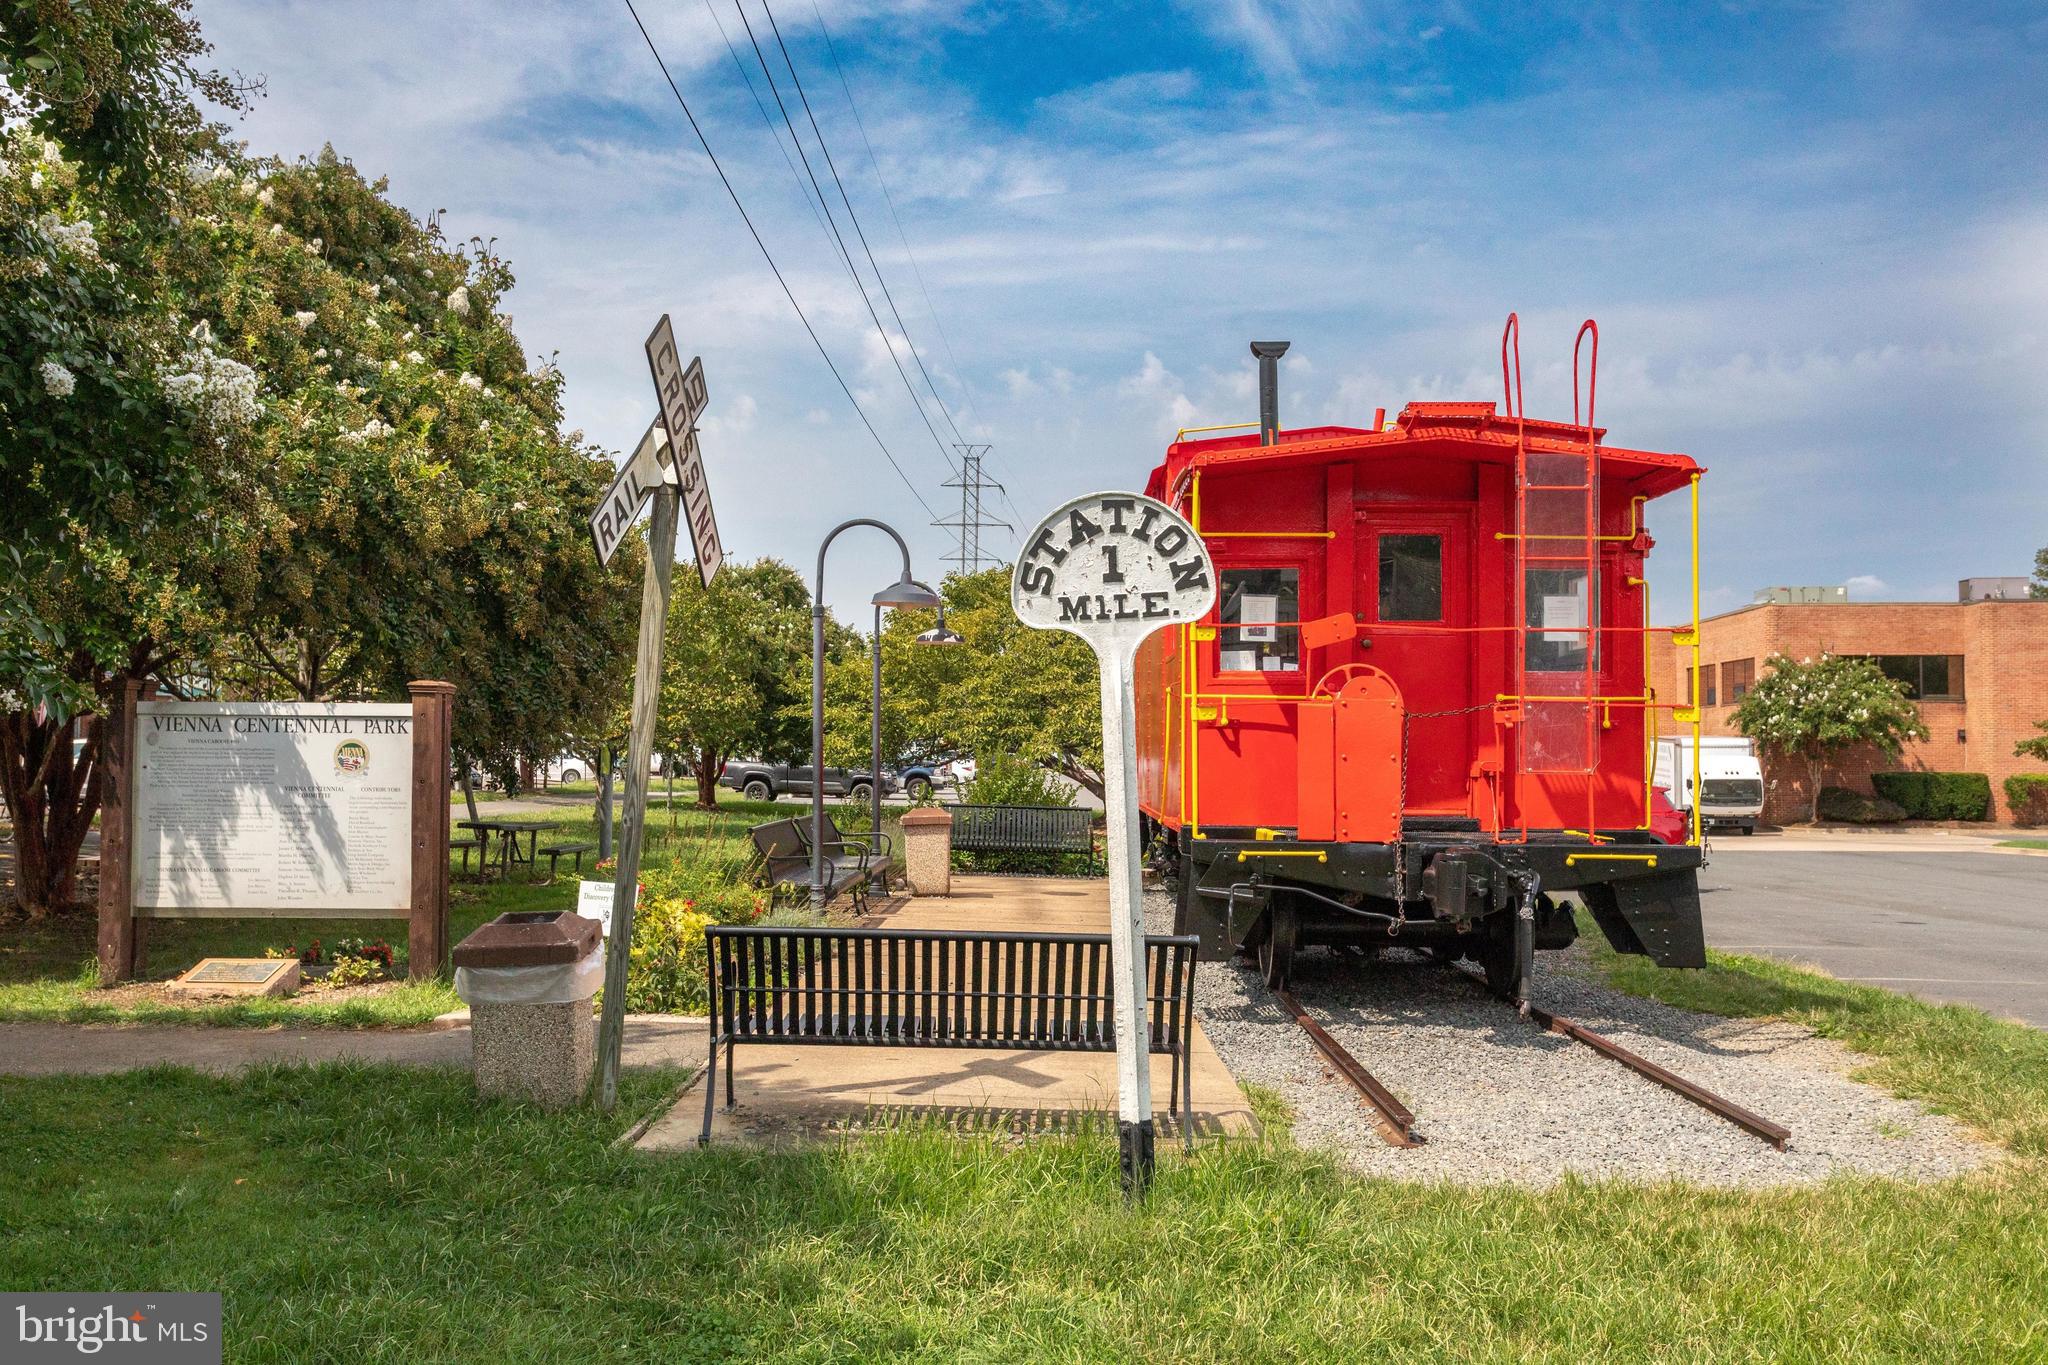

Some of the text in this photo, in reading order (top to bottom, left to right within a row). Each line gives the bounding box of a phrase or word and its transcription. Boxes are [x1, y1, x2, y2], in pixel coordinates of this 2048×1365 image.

[656, 341, 716, 566] CROSSING
[598, 470, 647, 551] RAIL
[1020, 499, 1209, 596] STATION
[1101, 545, 1125, 583] 1
[152, 716, 409, 734] VIENNA CENTENNIAL PARK
